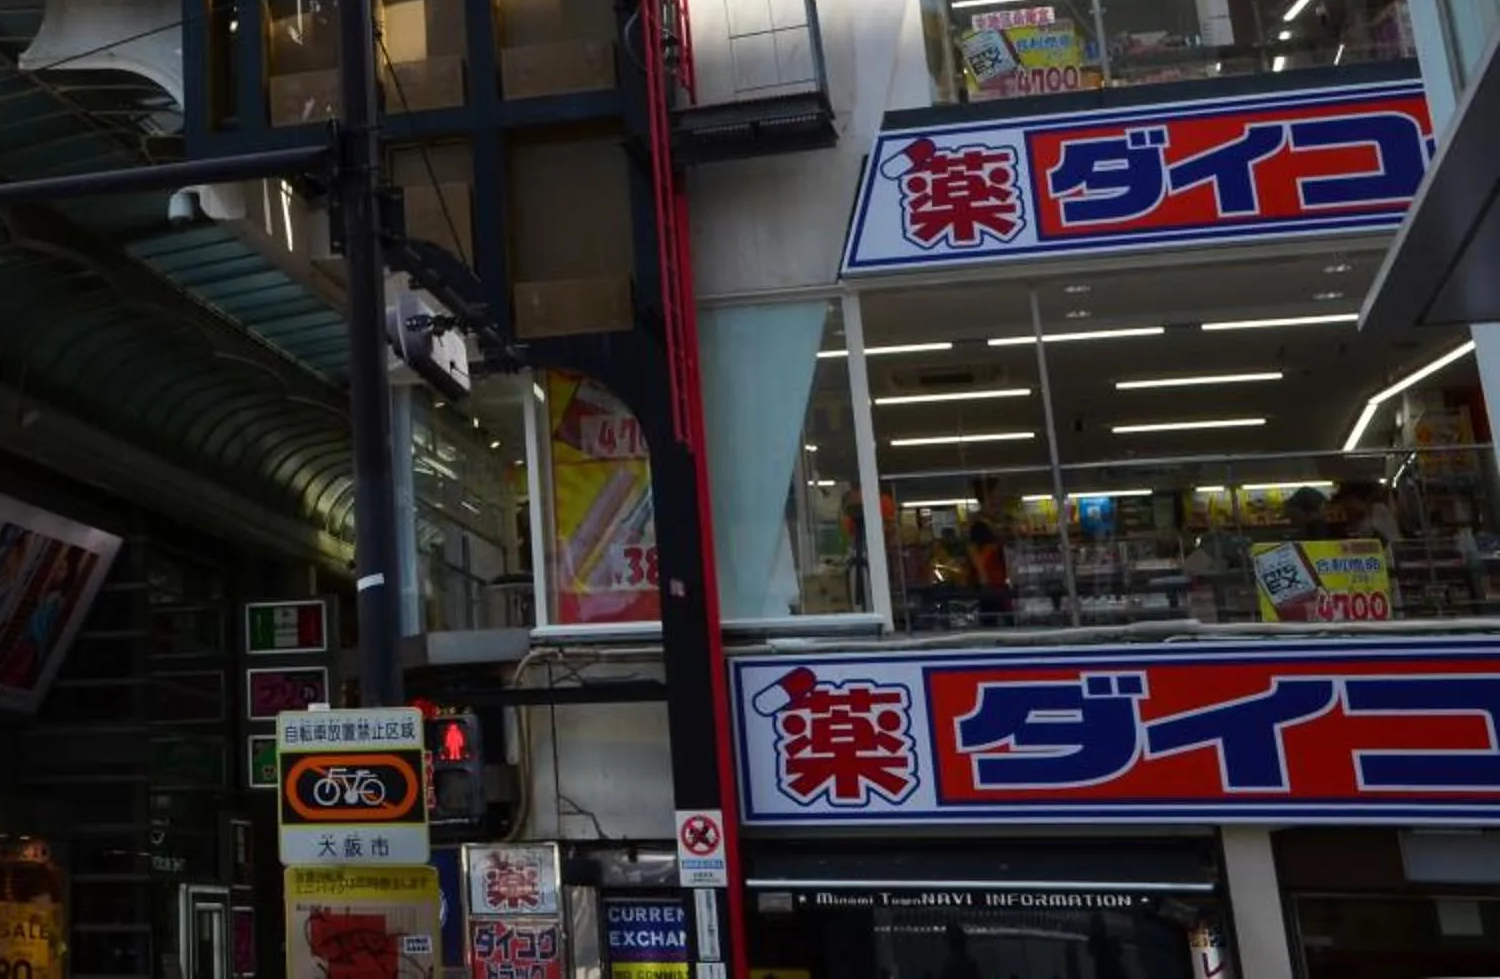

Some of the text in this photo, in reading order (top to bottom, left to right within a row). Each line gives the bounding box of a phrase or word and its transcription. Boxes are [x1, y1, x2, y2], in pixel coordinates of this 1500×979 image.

[900, 113, 1436, 247] 薬 ダイコ
[772, 671, 1500, 807] 薬 ダイコ
